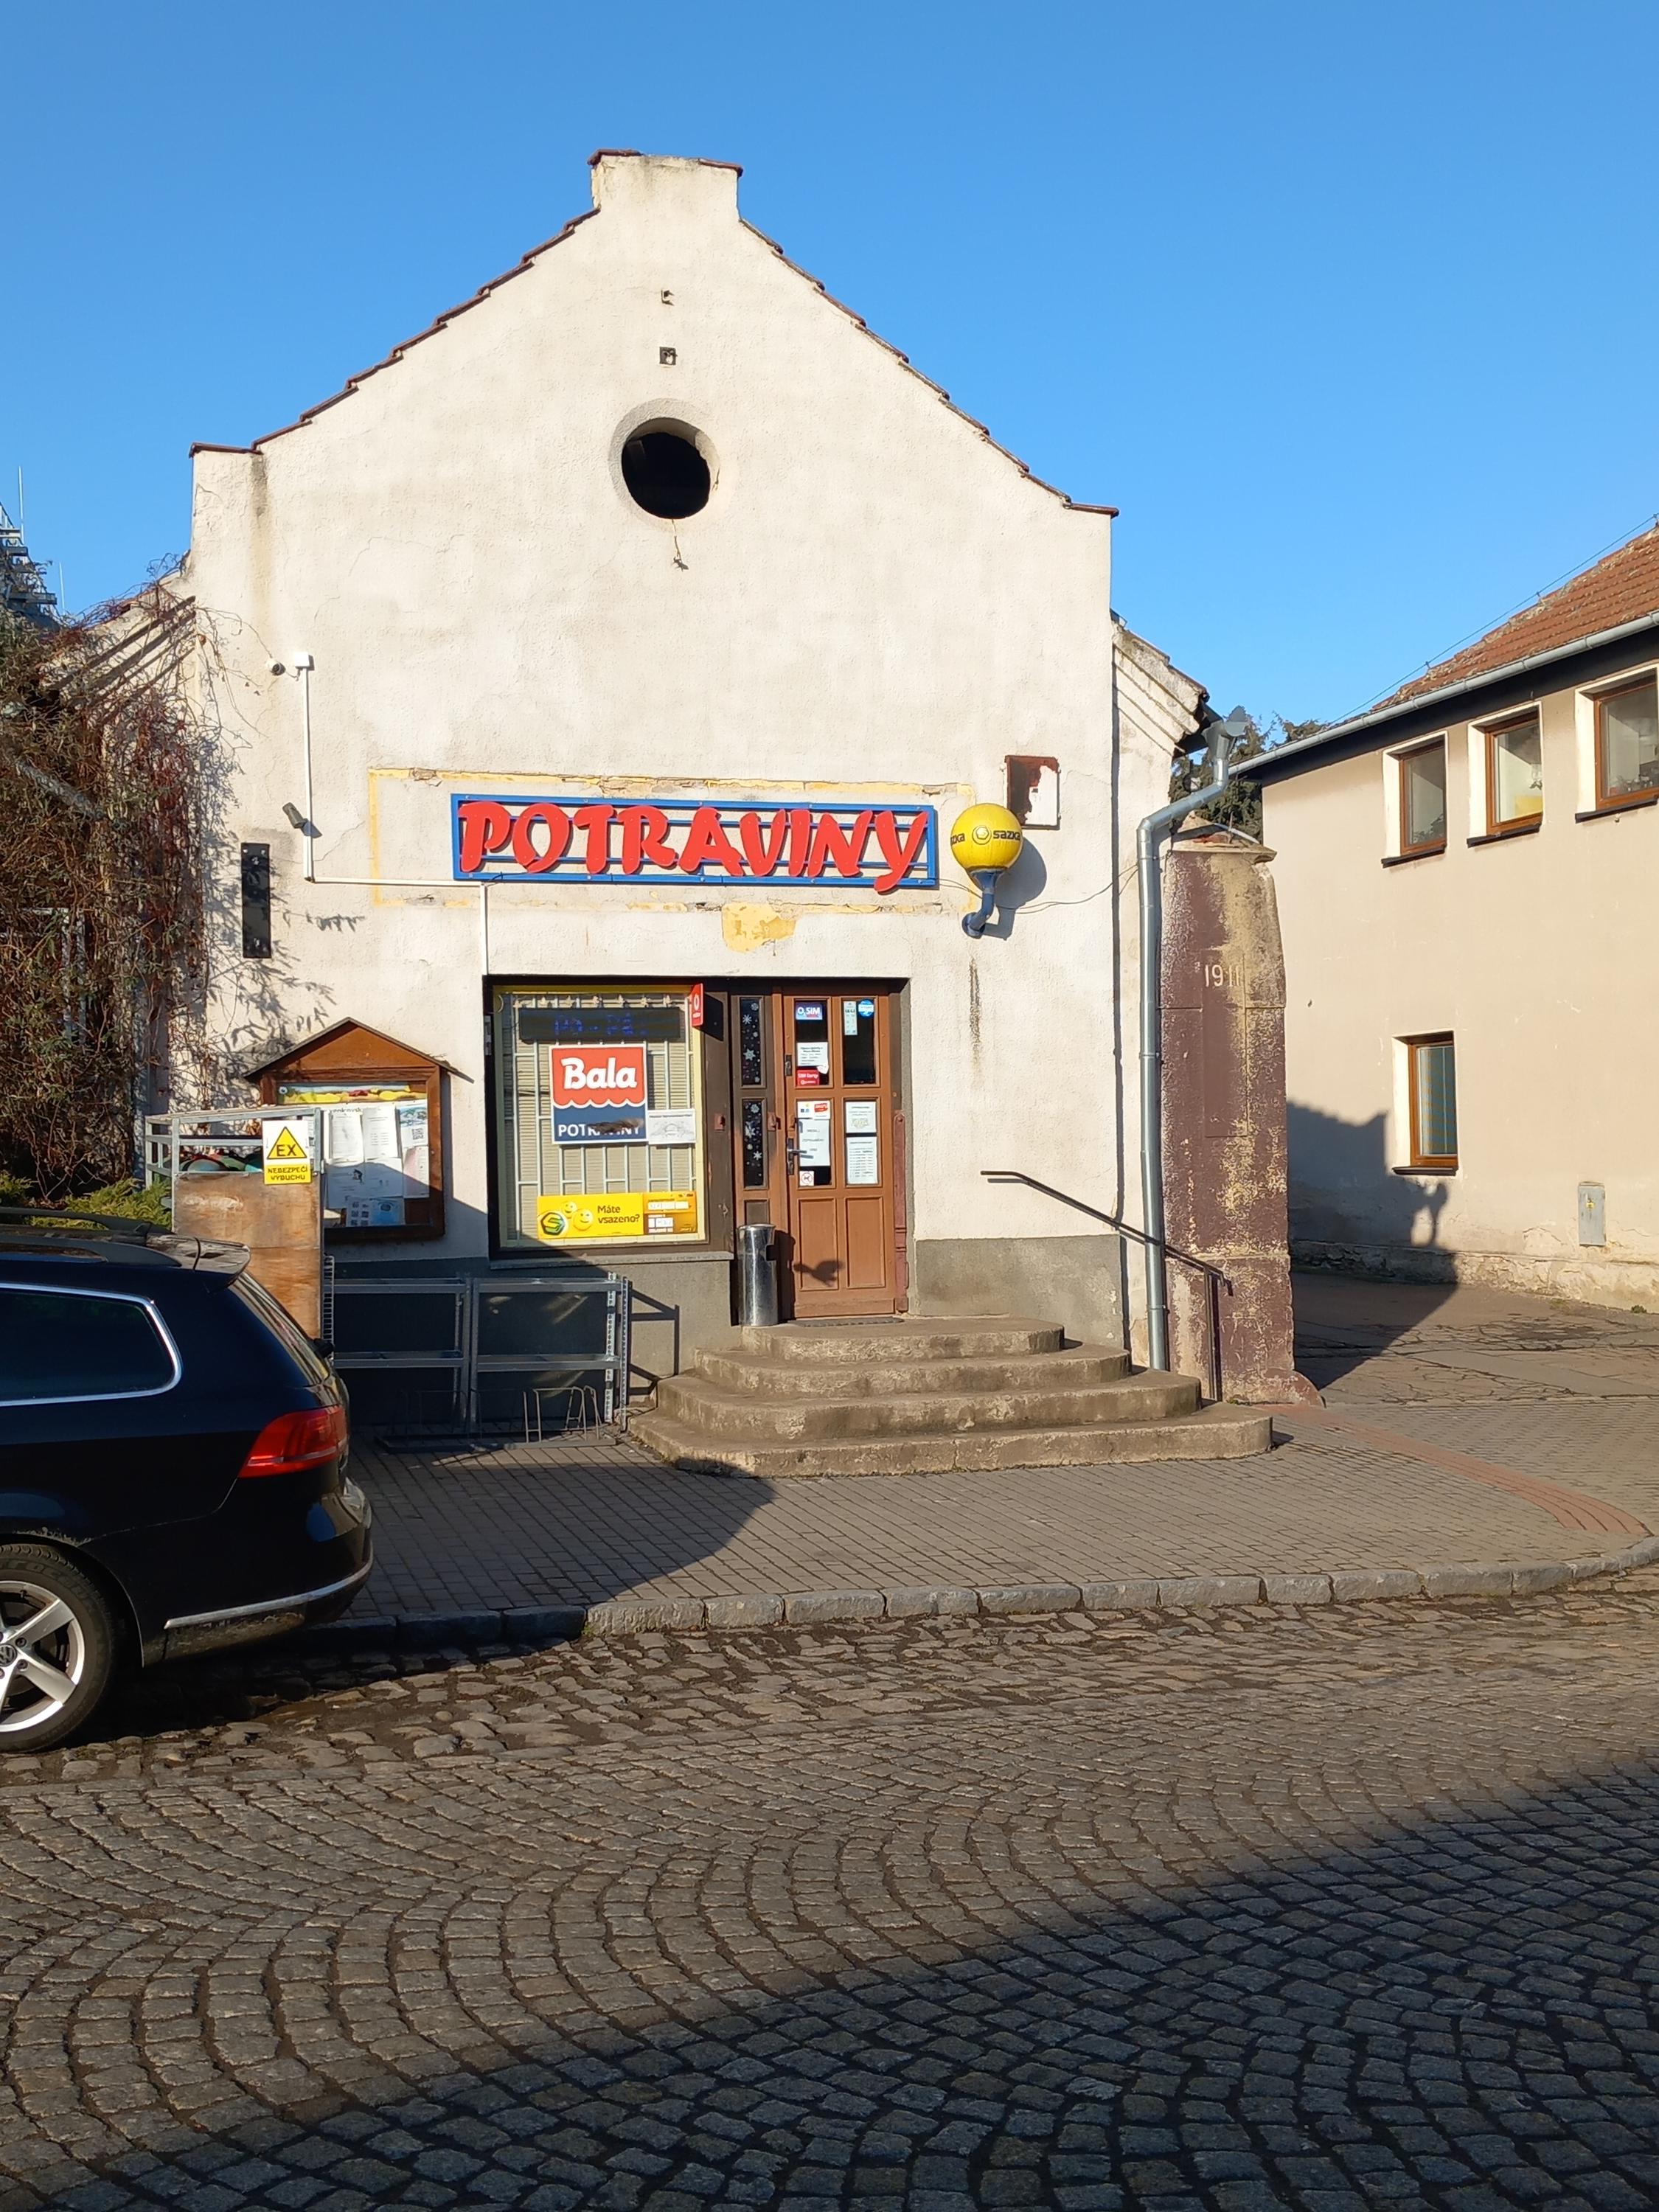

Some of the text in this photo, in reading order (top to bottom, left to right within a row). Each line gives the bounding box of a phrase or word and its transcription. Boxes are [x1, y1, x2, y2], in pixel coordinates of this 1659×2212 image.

[459, 801, 929, 894] POTRAVINY
[806, 1006, 820, 1015] SIM
[561, 1057, 637, 1089] Bala
[276, 1144, 296, 1157] EX
[597, 1205, 621, 1214] Máte
[598, 1214, 640, 1224] vsazeno?
